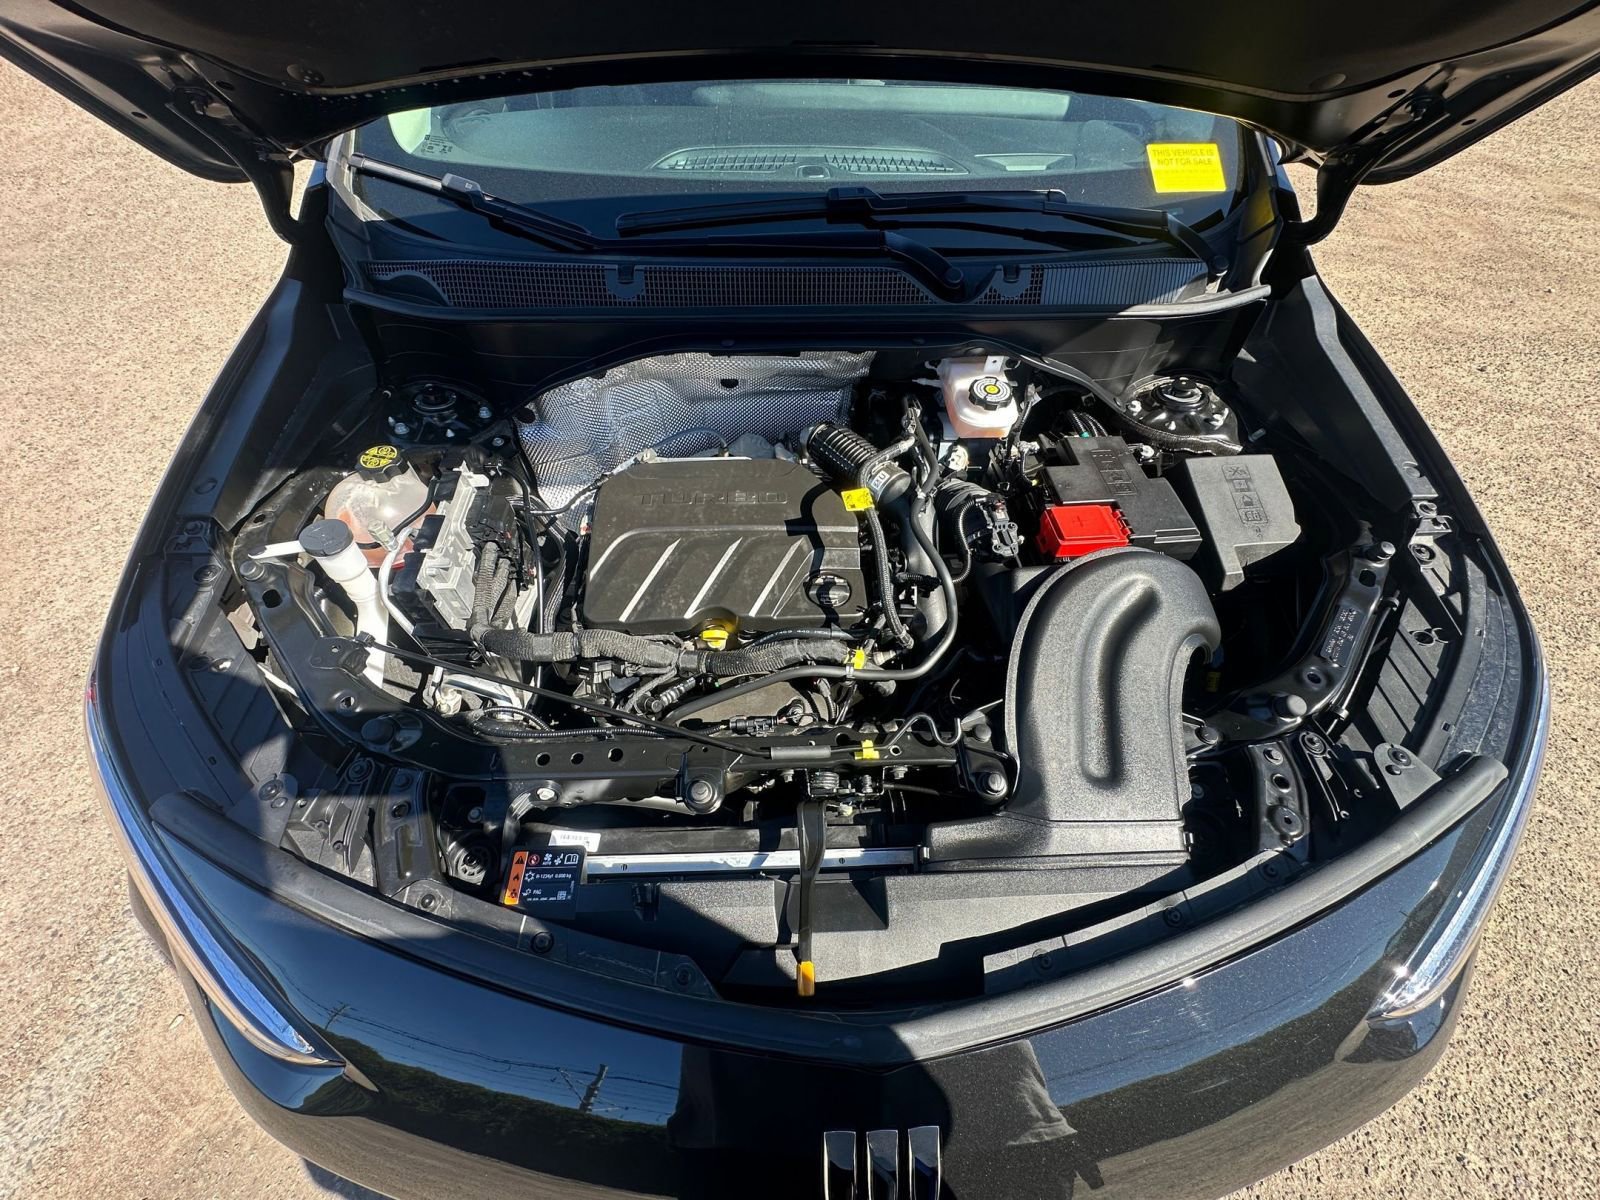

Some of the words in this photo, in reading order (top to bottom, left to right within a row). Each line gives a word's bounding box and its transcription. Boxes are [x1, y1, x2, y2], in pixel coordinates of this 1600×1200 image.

[1152, 149, 1172, 157] THIS
[1172, 149, 1205, 157] VEHICLE
[1157, 158, 1174, 166] NOT
[1174, 158, 1191, 166] FOR
[634, 491, 789, 505] TURBO
